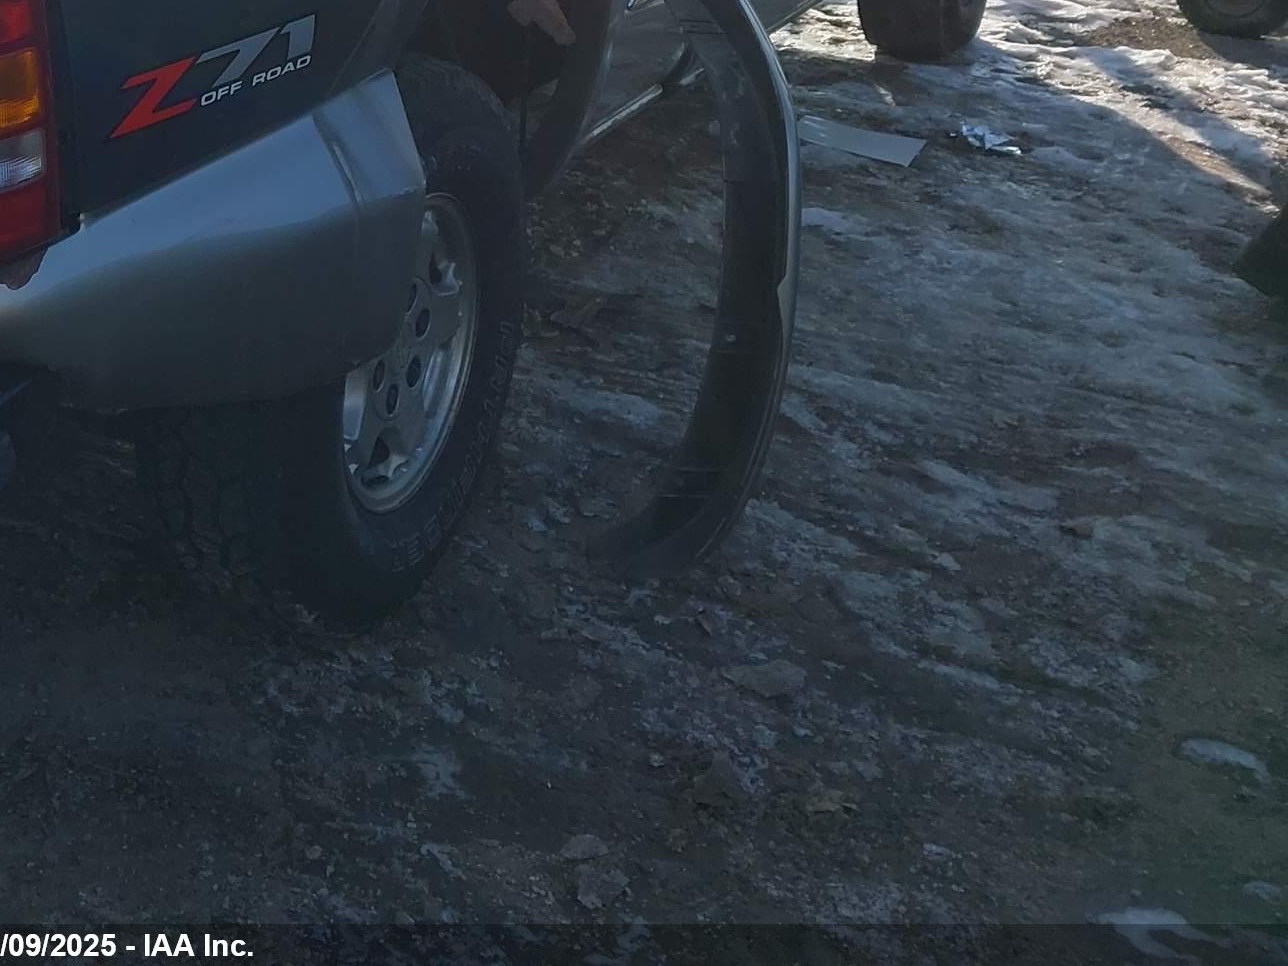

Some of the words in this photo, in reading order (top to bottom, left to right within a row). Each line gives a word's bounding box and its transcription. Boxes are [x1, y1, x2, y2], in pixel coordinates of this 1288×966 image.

[109, 14, 315, 139] Z71
[200, 80, 243, 107] OFF
[252, 54, 311, 86] ROAD
